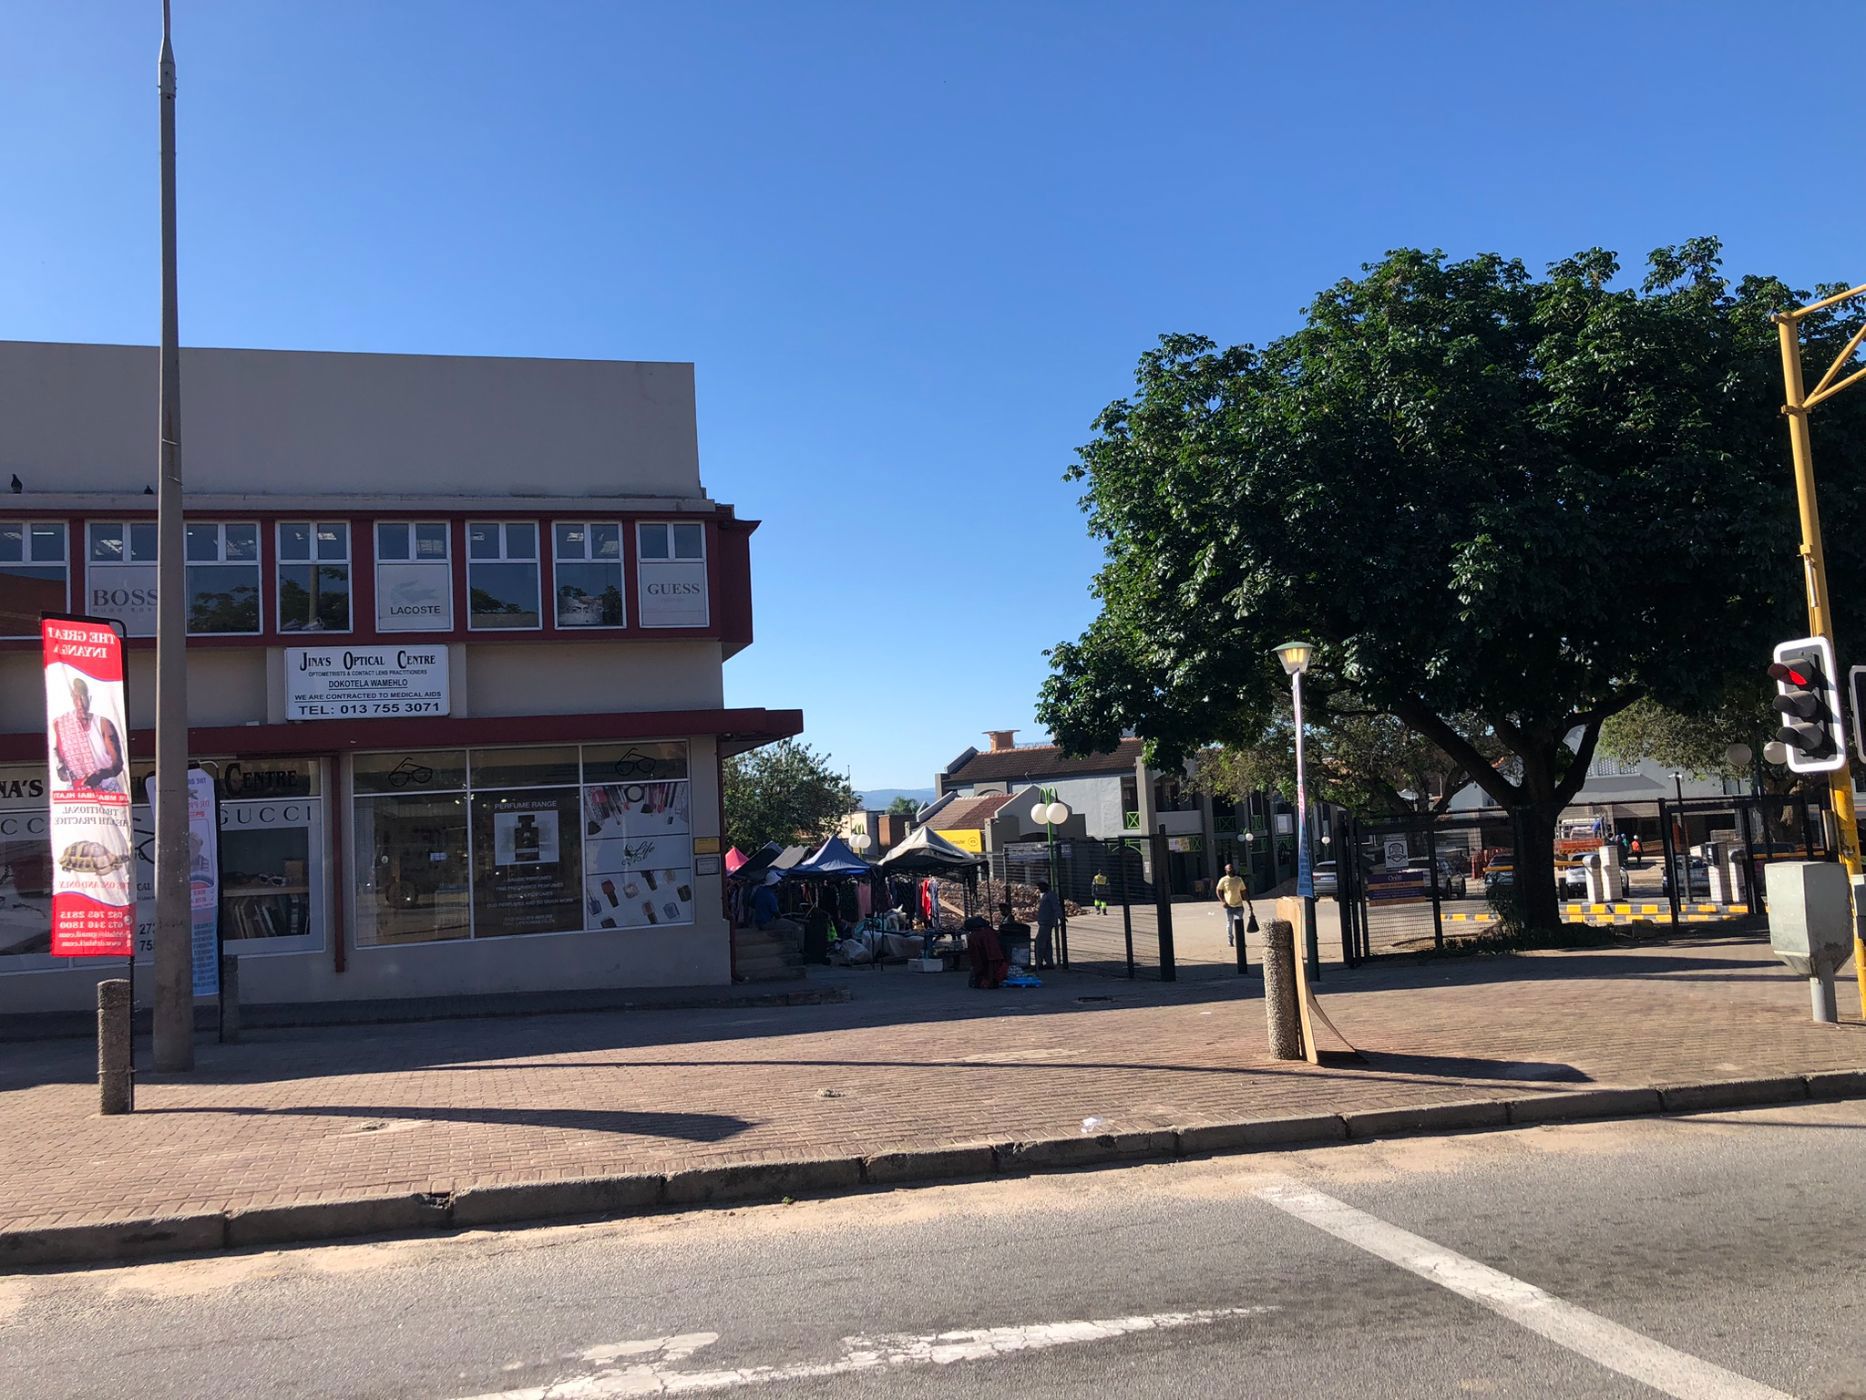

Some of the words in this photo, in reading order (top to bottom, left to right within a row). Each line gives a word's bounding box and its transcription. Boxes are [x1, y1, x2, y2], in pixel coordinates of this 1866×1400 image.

[647, 583, 700, 595] GUESS
[93, 588, 157, 606] BOSS
[390, 605, 441, 615] LACOSTE
[299, 652, 331, 671] JINA'S
[343, 651, 385, 670] OPTICAL
[397, 650, 436, 669] CENTRE
[328, 680, 369, 688] DOKOTELA
[370, 678, 408, 687] WAMEHLO
[325, 692, 377, 700] CONTRACTED
[298, 705, 335, 715] TEL:
[340, 704, 368, 714] 013
[373, 703, 400, 713] 755
[404, 702, 439, 713] 3071
[225, 763, 297, 795] CENTRE
[494, 801, 530, 809] PERFUME
[532, 800, 557, 808] RANGE
